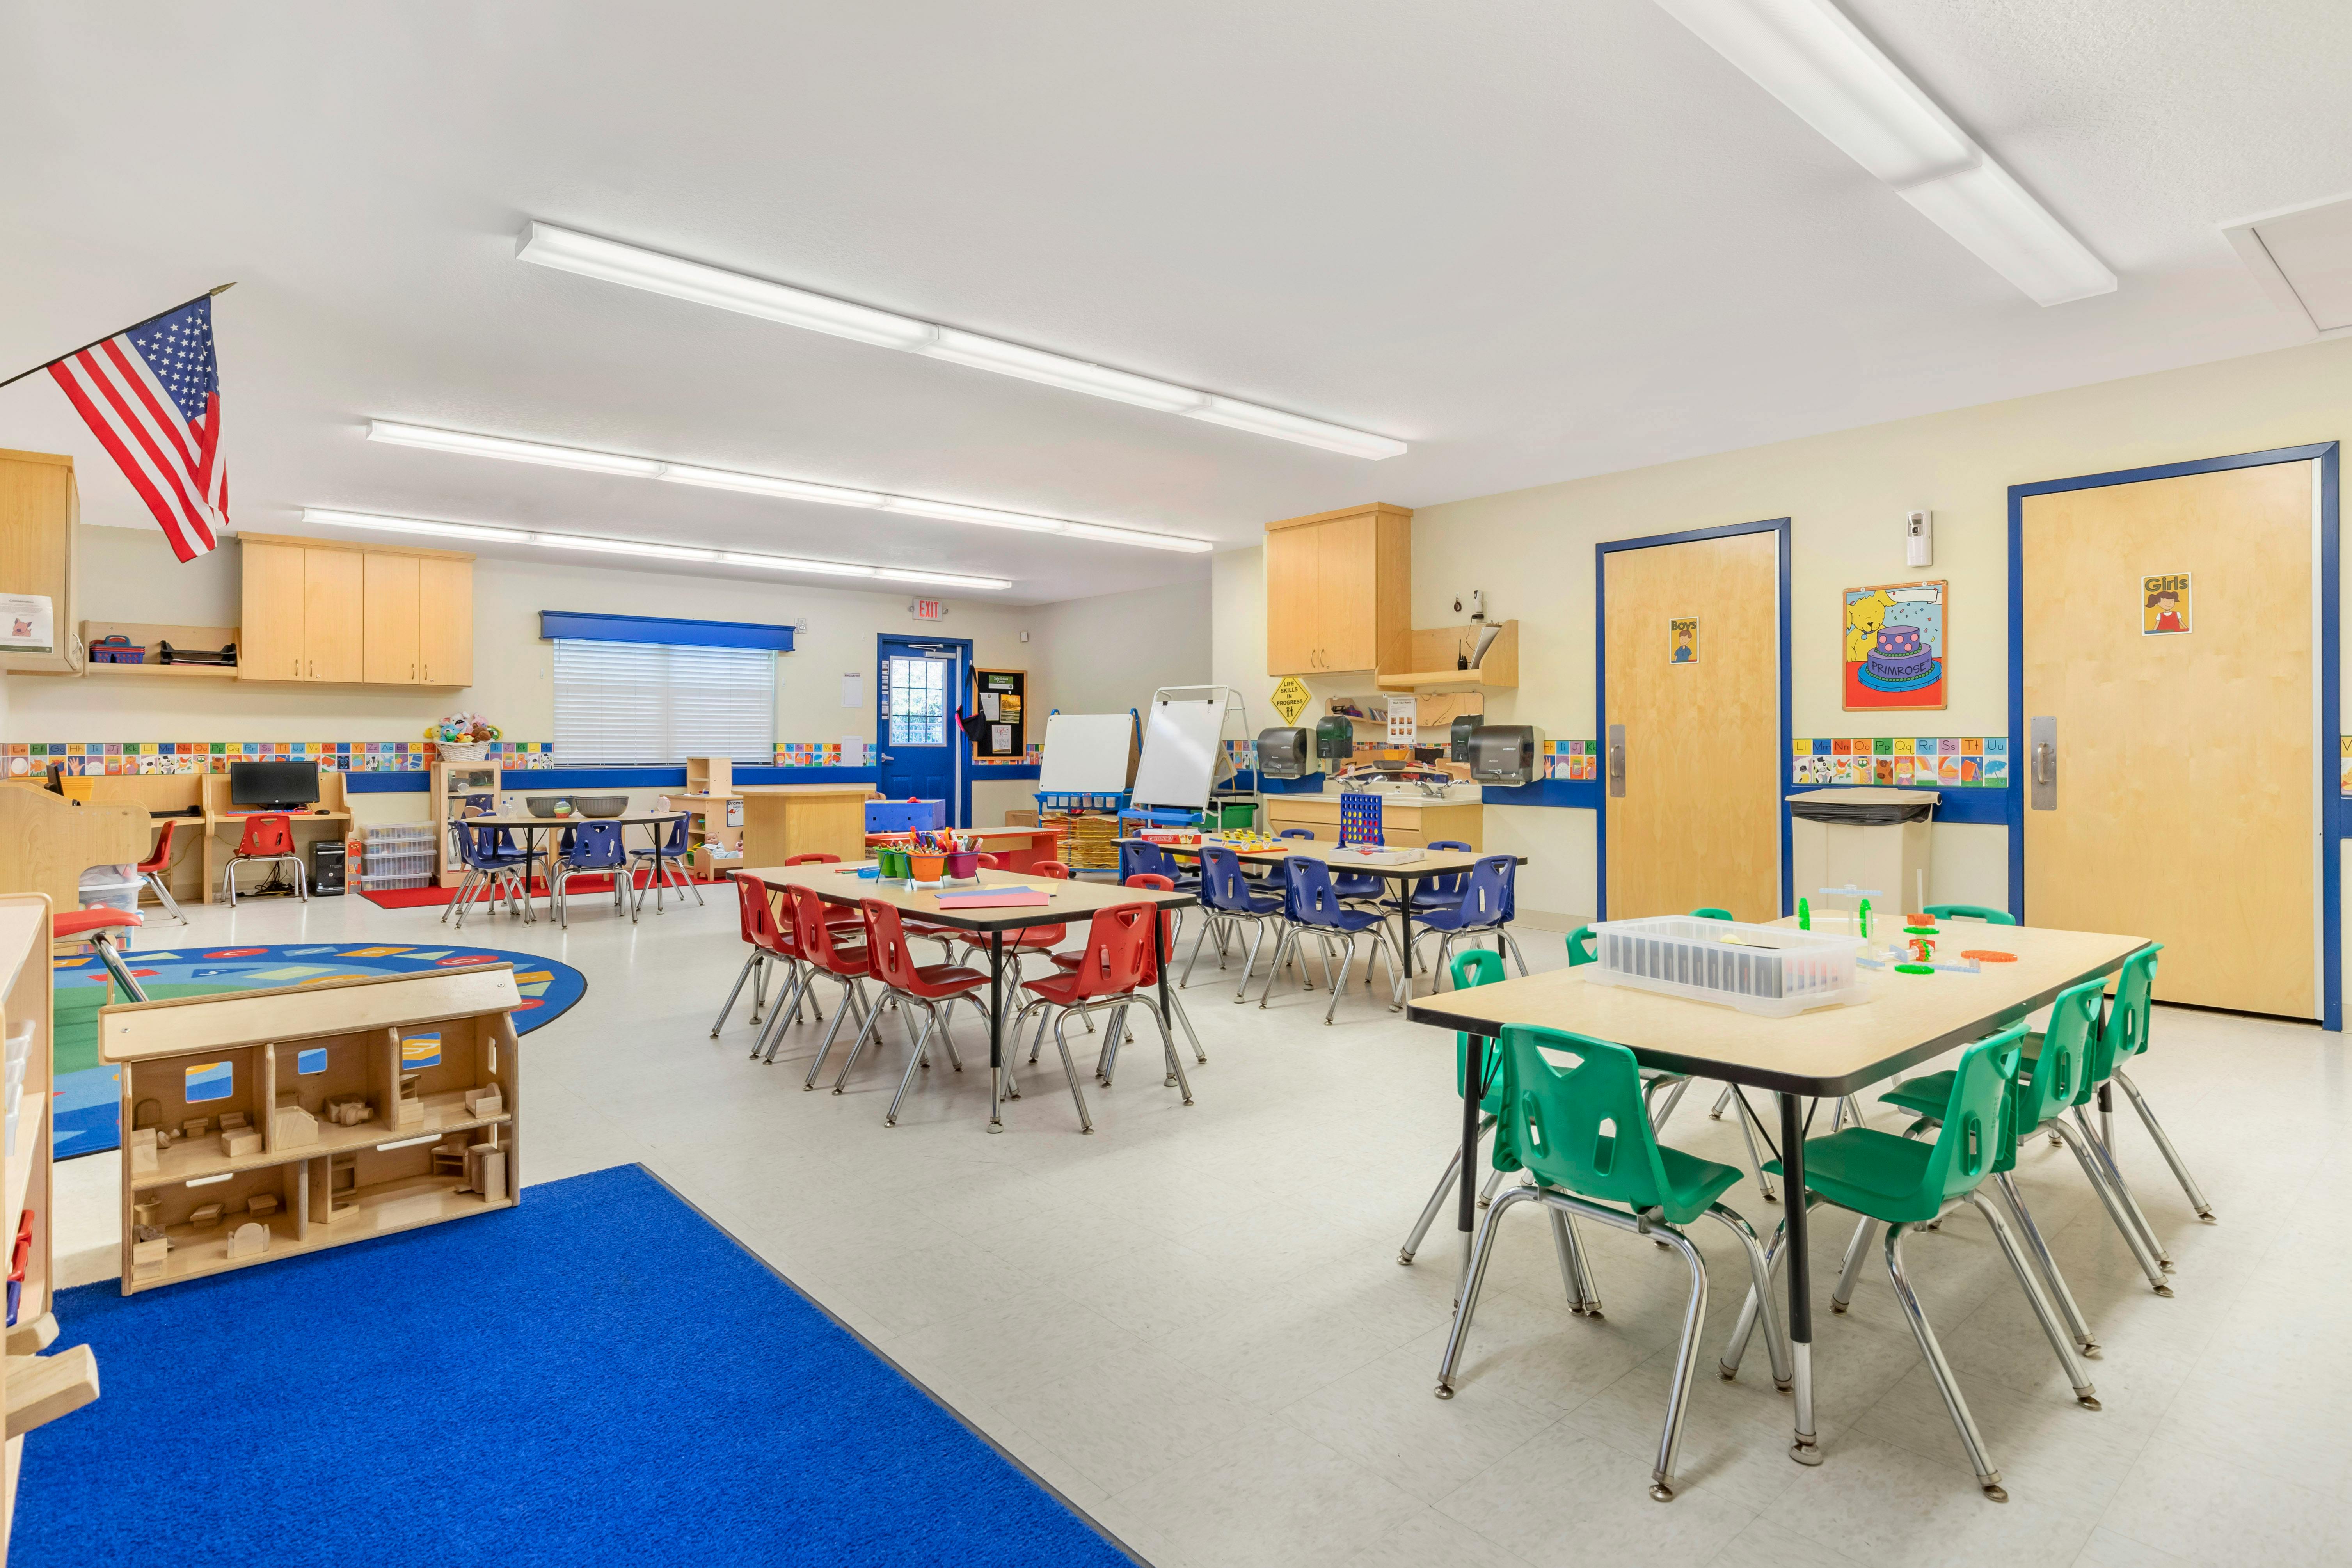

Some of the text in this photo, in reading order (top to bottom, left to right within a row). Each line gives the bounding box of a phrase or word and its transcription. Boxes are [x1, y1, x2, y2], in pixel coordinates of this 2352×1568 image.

[2145, 576, 2188, 592] Girls
[919, 600, 939, 618] EXIT
[1672, 620, 1697, 630] Boys
[50, 745, 65, 755] Gg
[107, 745, 119, 755] Jj
[211, 744, 224, 753] Pp
[227, 744, 241, 754] Qq
[353, 744, 363, 753] Yy
[1561, 742, 1565, 751] Ii
[1572, 742, 1581, 754] Jj
[1587, 742, 1596, 751] Kk
[1797, 740, 2003, 755] Ll Mm Nn Oo Pp Qq Rr Ss Tt Uu
